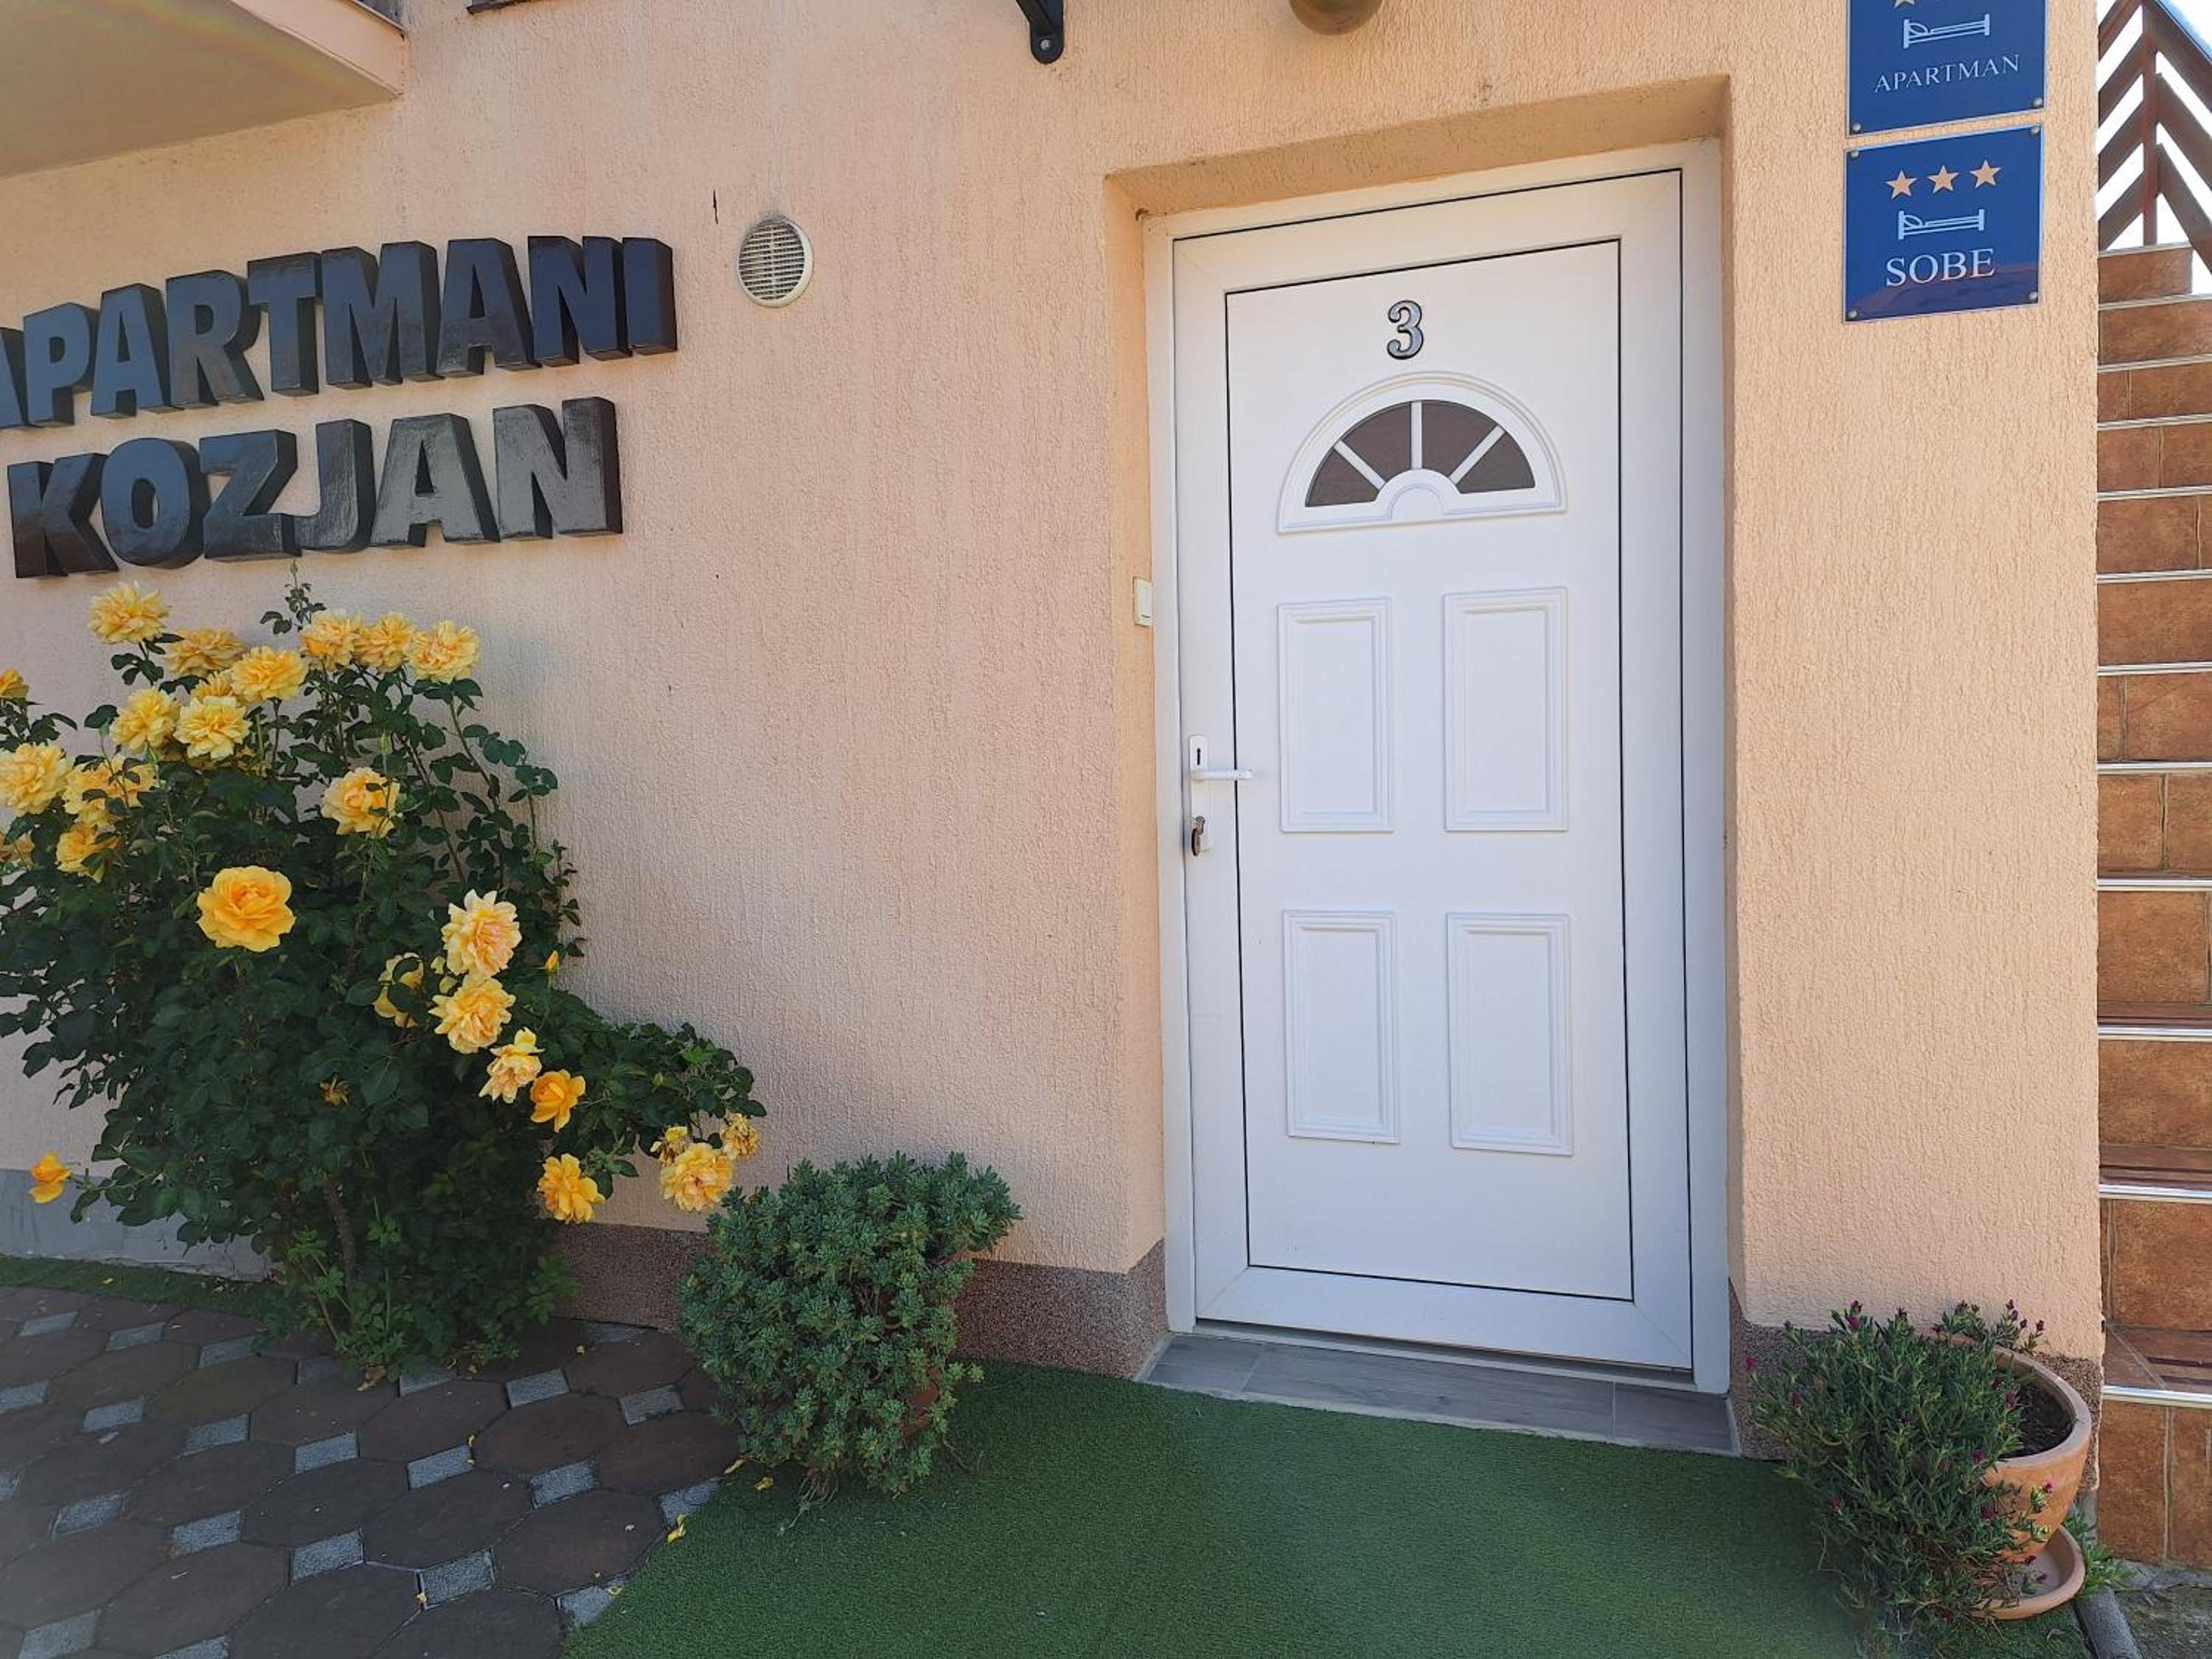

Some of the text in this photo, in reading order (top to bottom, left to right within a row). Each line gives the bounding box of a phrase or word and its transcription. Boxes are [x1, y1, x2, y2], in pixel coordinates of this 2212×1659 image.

[1874, 54, 2020, 93] APARTMAN
[1885, 248, 1994, 287] SOBE
[1387, 299, 1424, 360] 3
[7, 396, 624, 579] KOZJAN
